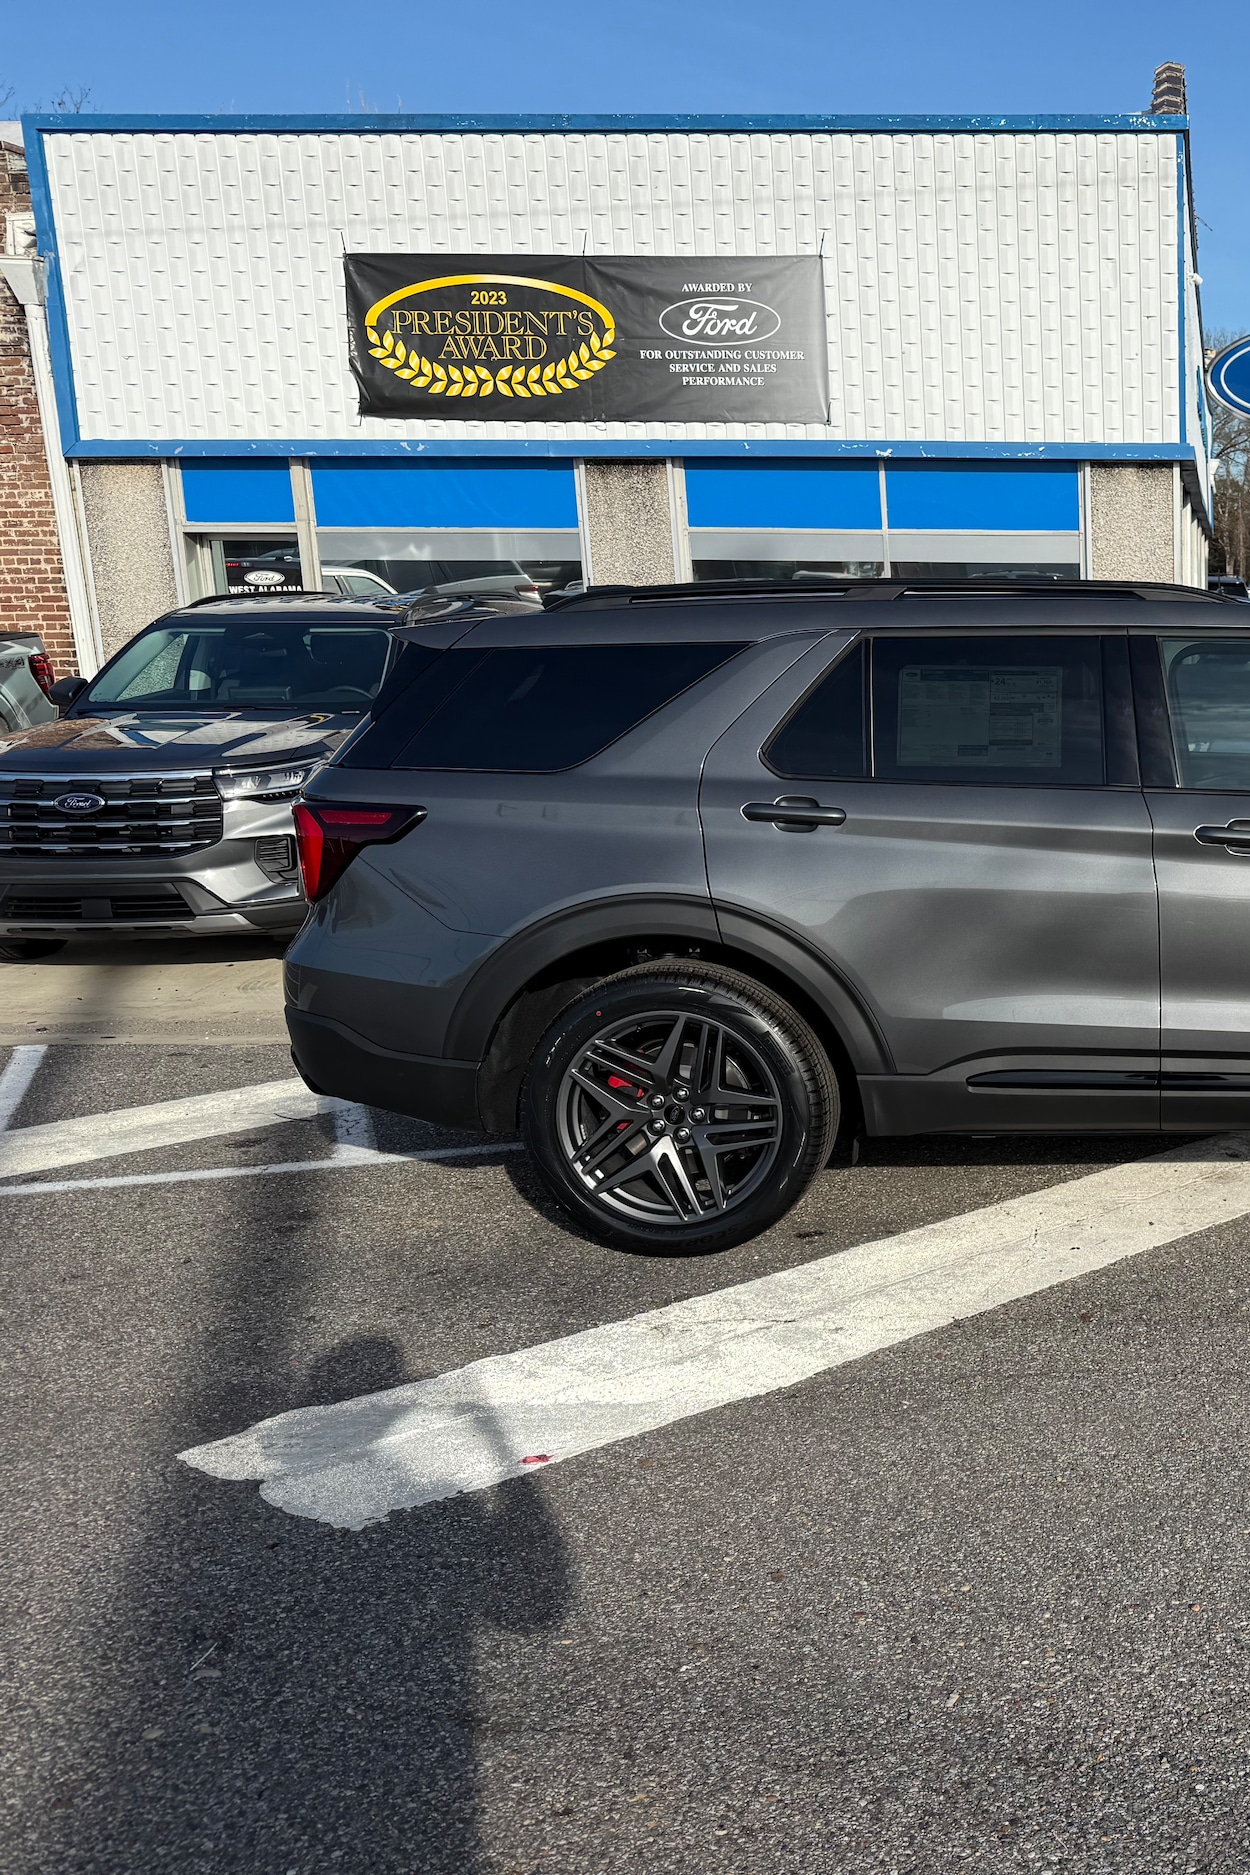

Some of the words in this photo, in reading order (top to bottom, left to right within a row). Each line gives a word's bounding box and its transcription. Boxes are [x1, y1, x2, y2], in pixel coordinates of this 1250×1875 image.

[681, 283, 735, 292] AWARDED
[738, 283, 753, 292] BY
[470, 290, 508, 305] 2023
[391, 310, 595, 336] PRESIDENT'S
[682, 303, 758, 336] Ford
[438, 335, 548, 361] AWARD
[640, 350, 663, 360] FOR
[665, 350, 742, 360] OUTSTANDING
[744, 350, 806, 361] CUSTOMER
[669, 363, 716, 373] SERVICE
[718, 363, 741, 373] AND
[743, 363, 777, 373] SALES
[682, 376, 765, 387] PERFORMANCE
[253, 573, 276, 582] Ford
[228, 585, 256, 594] WEST
[64, 796, 92, 809] Ford
